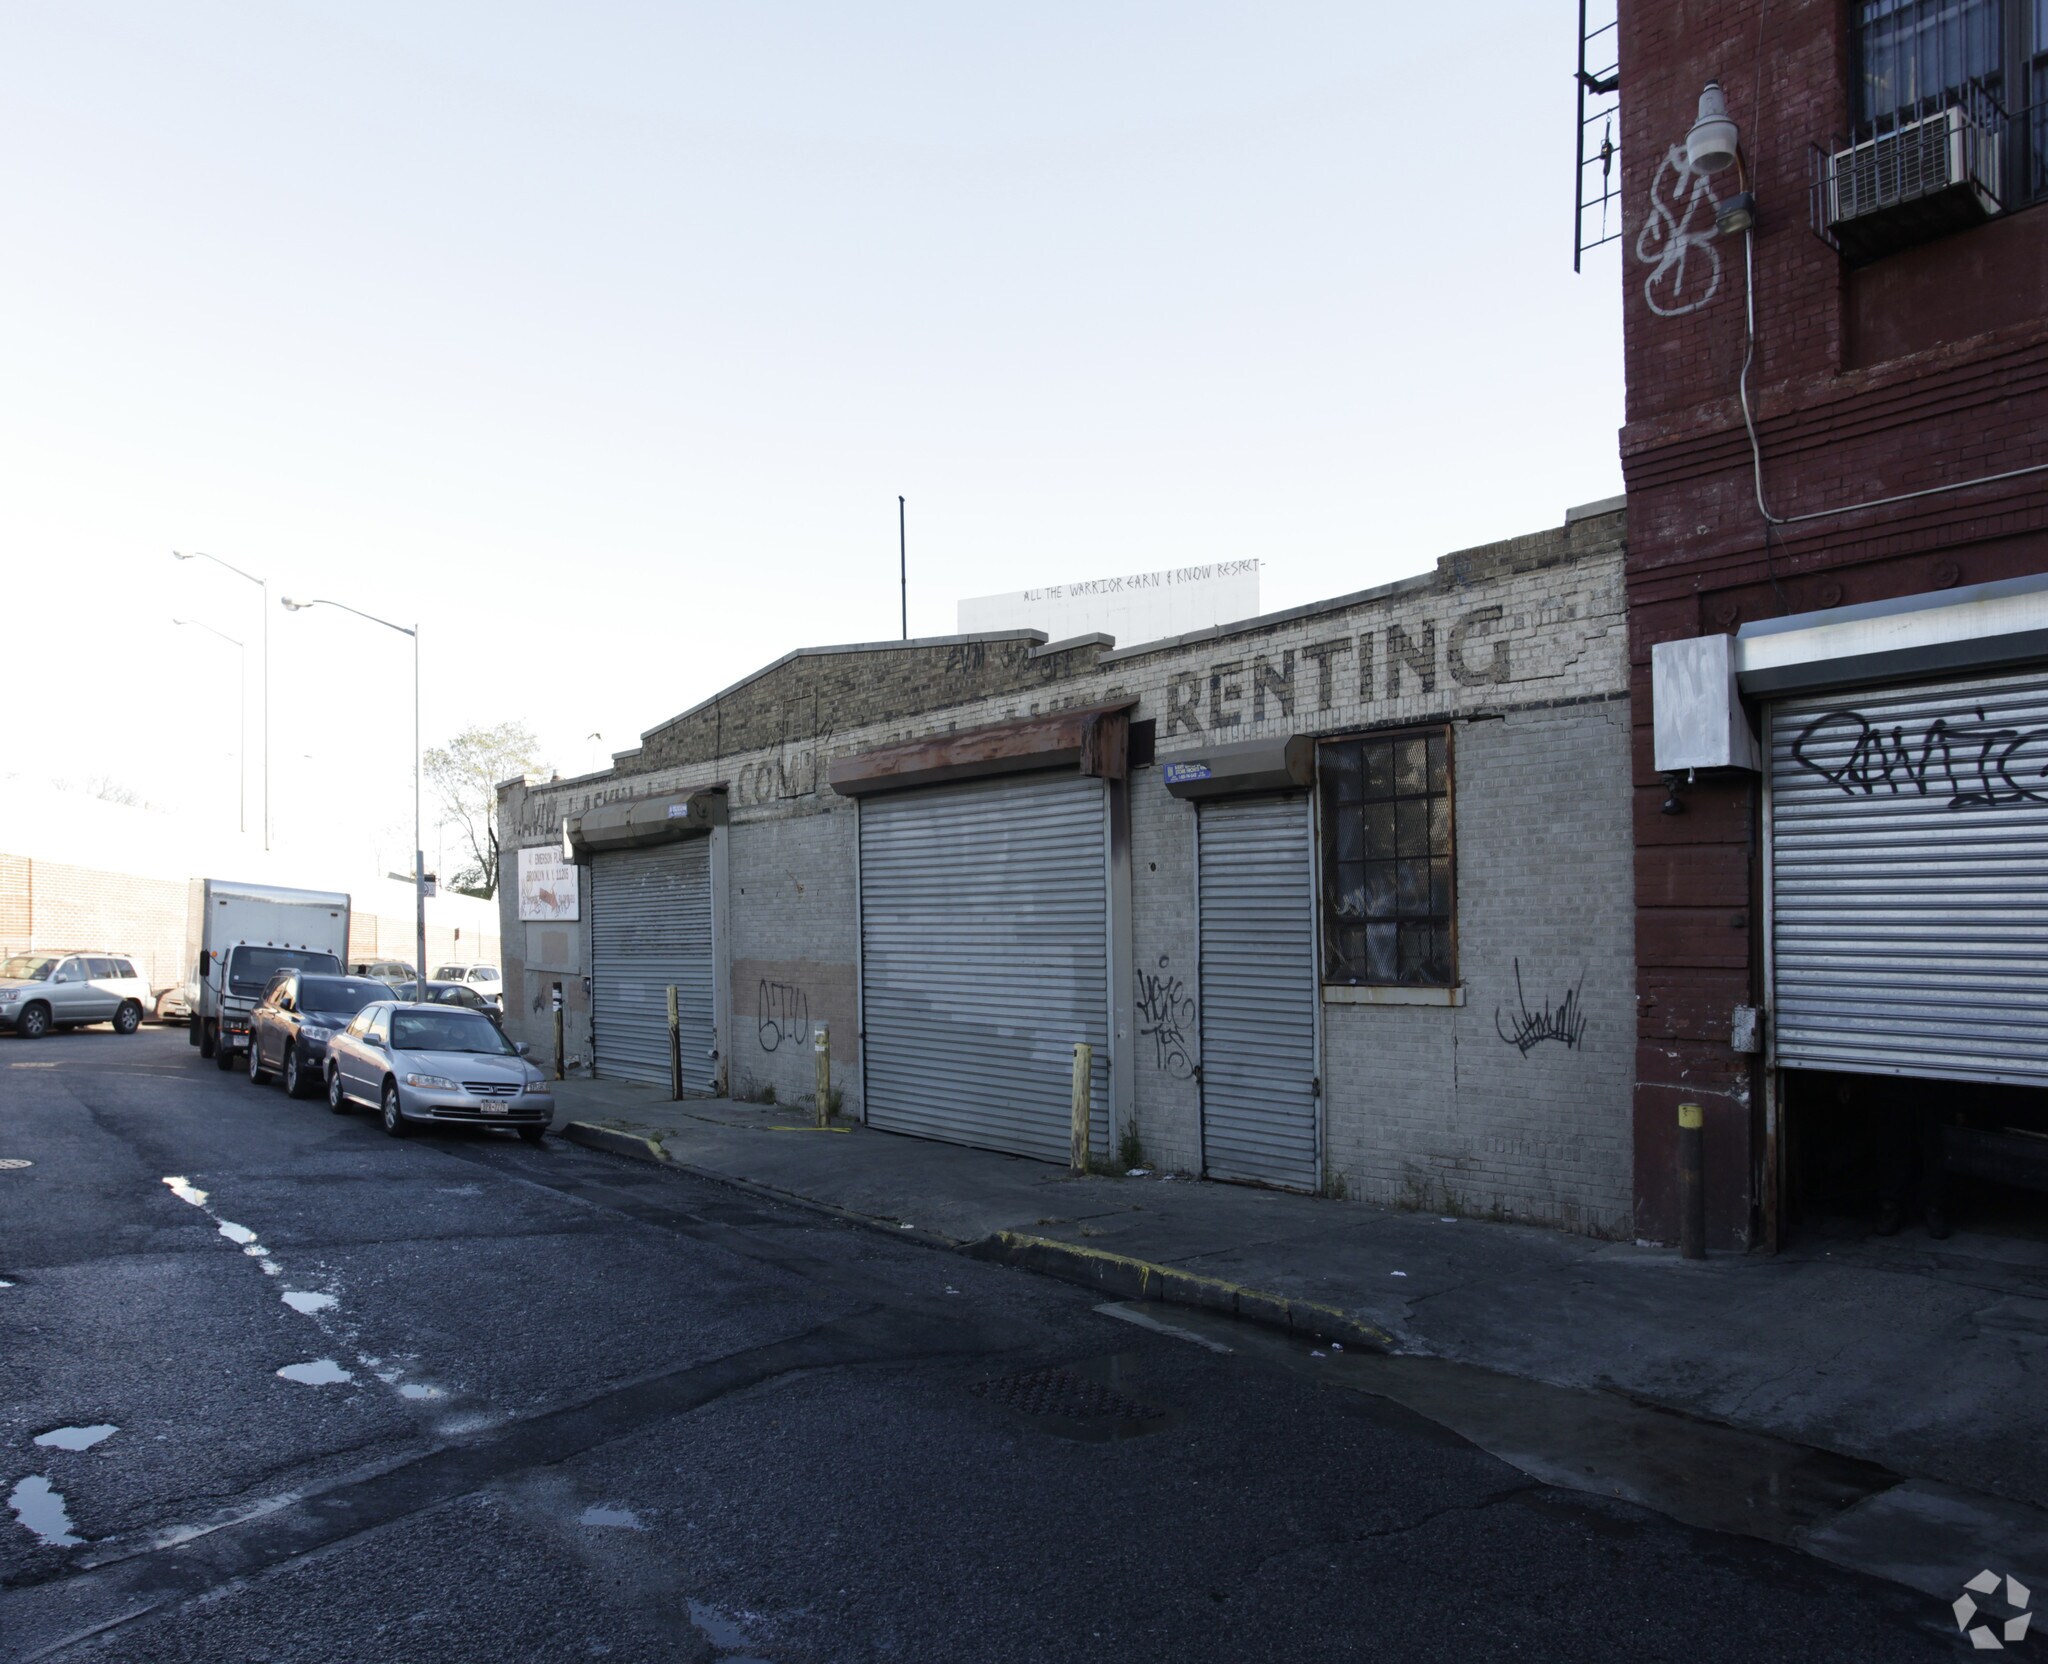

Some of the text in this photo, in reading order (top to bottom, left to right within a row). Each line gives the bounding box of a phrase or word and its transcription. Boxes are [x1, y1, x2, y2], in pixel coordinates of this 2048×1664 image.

[1024, 589, 1042, 602] ALL
[1045, 586, 1062, 599] THE
[1069, 577, 1124, 597] WARRIOR
[1126, 572, 1160, 589] EARN
[1176, 565, 1212, 584] KNOW
[1166, 604, 1511, 737] RENTING
[526, 870, 544, 881] BROOKLYN
